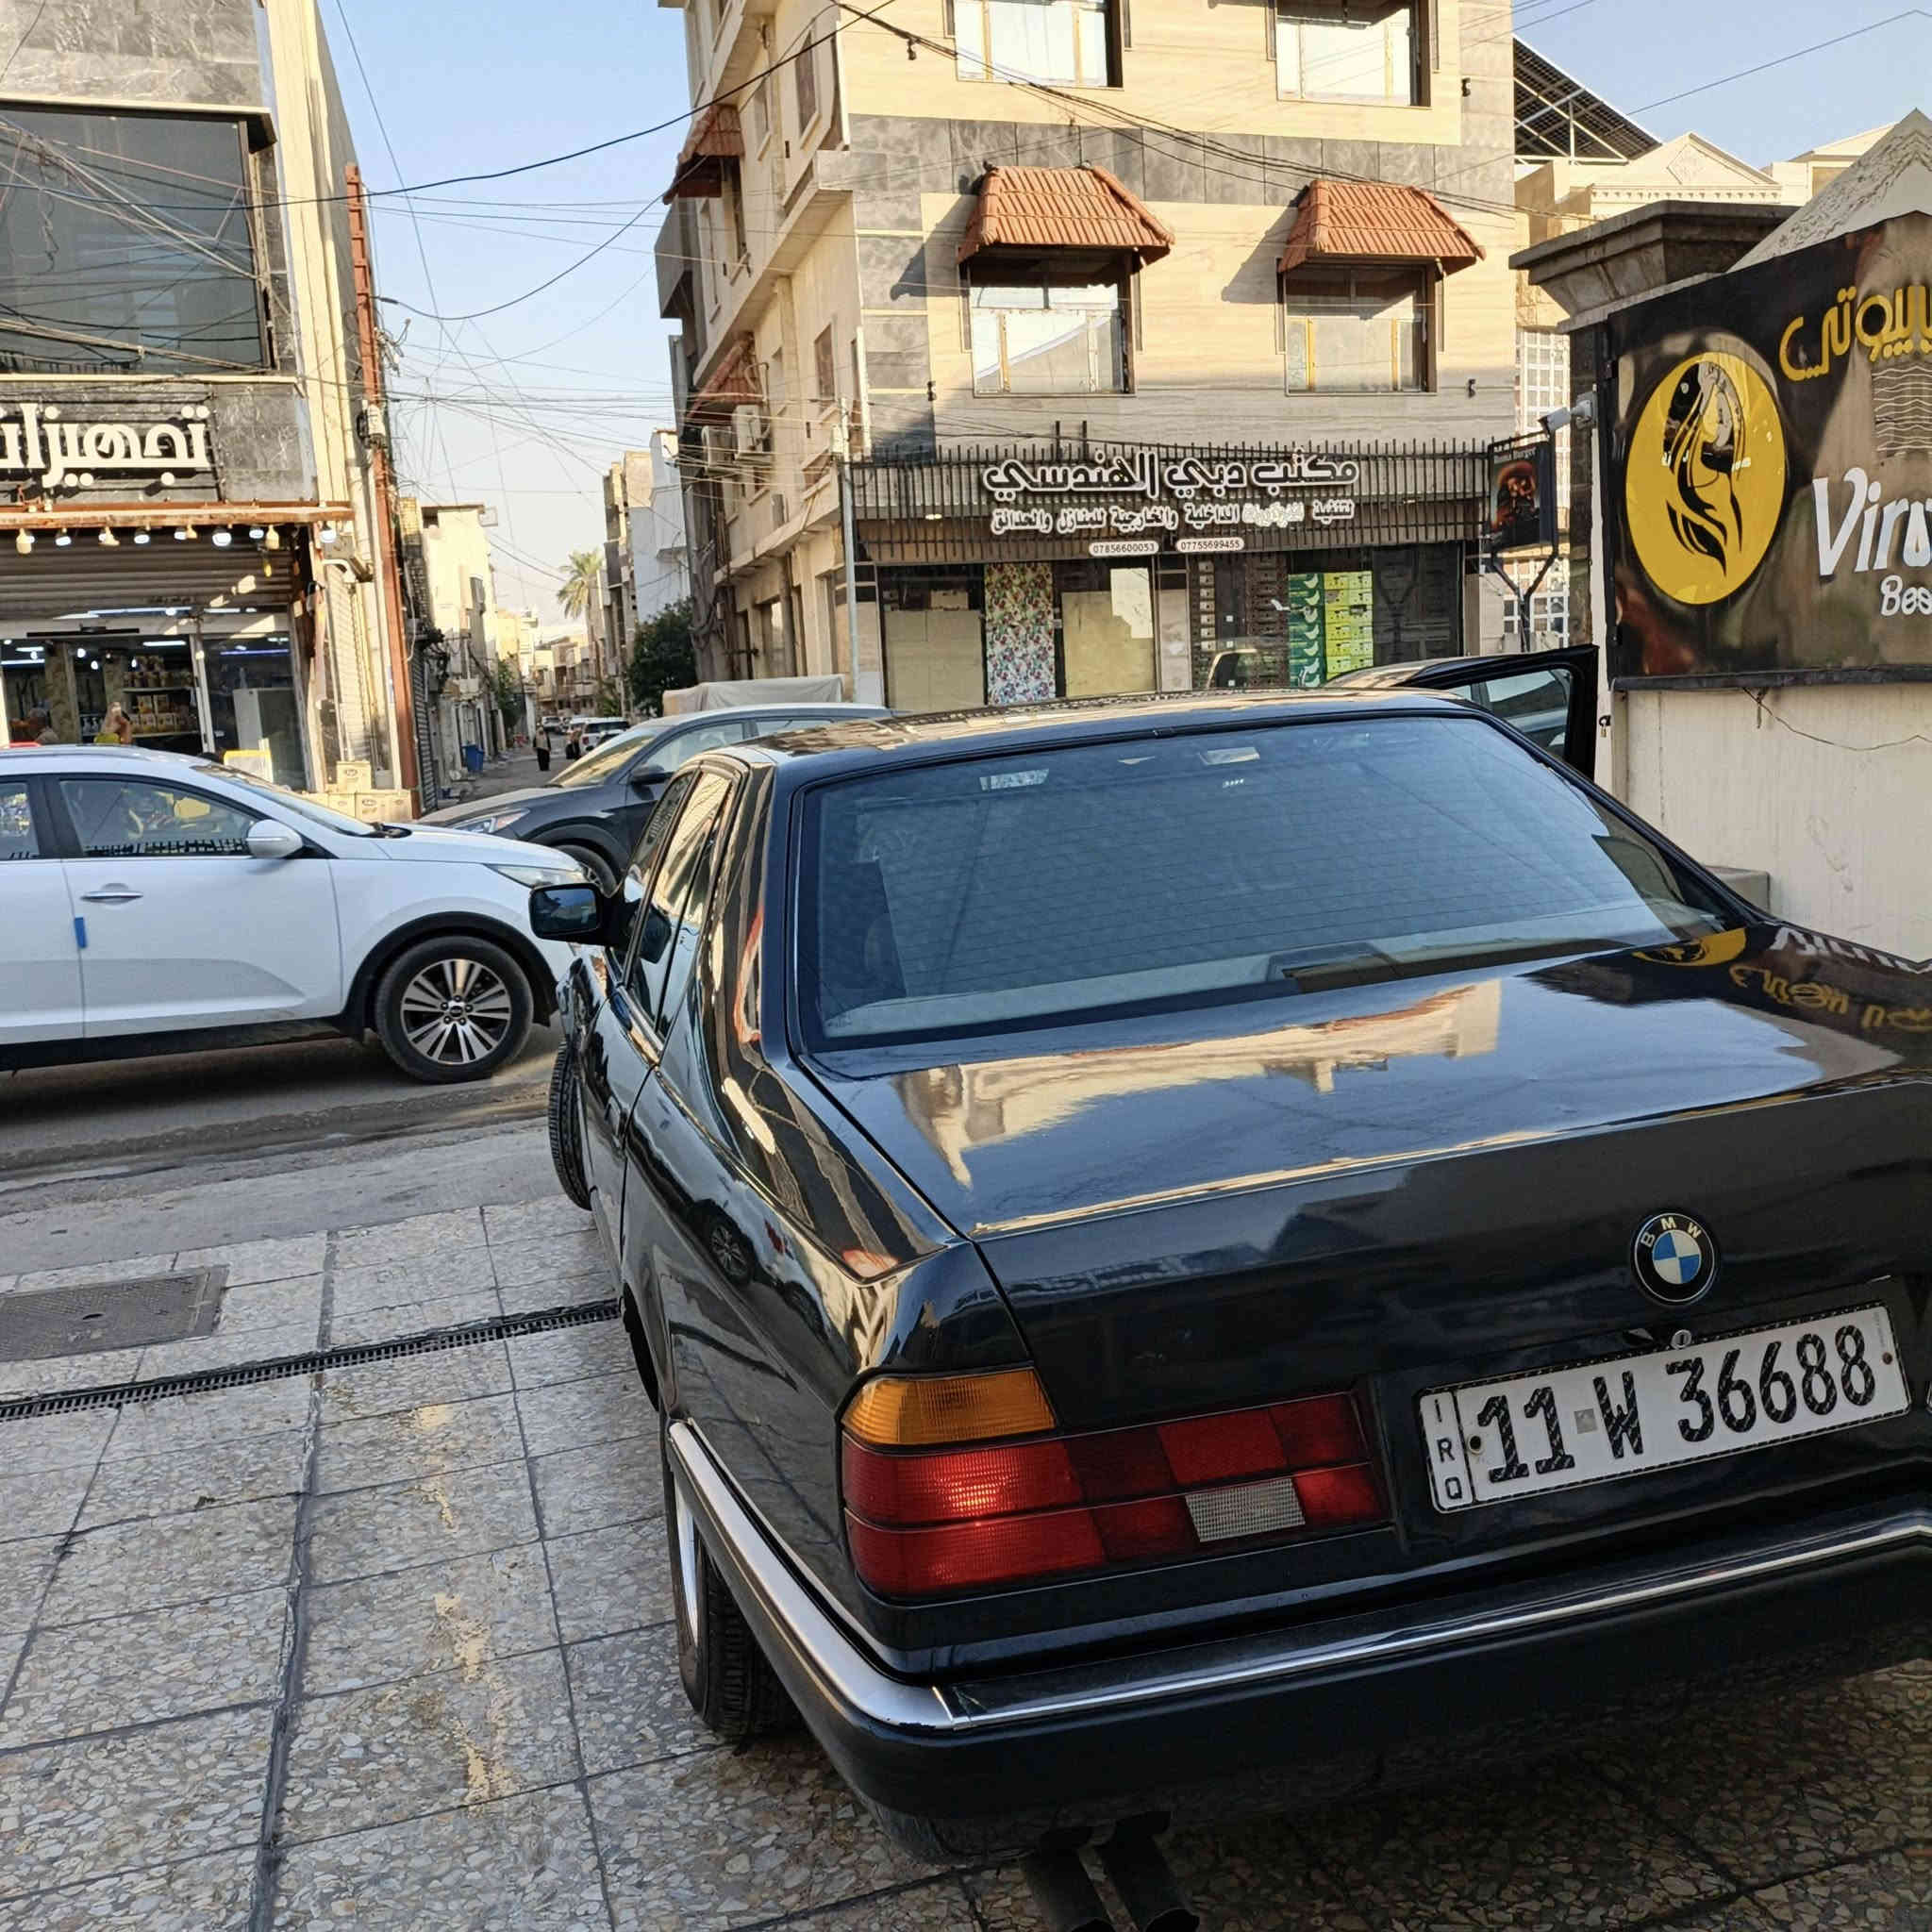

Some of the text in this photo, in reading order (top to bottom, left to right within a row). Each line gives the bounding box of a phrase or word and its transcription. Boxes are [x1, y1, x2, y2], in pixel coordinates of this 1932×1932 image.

[983, 447, 1358, 501] مكتب دبي الهندسي
[1057, 507, 1107, 534] للمنازل
[1109, 506, 1178, 533] والخارجية
[1184, 502, 1240, 529] الداخلية
[1641, 1216, 1702, 1248] BMW
[1477, 1325, 1875, 1483] 11 W 36688
